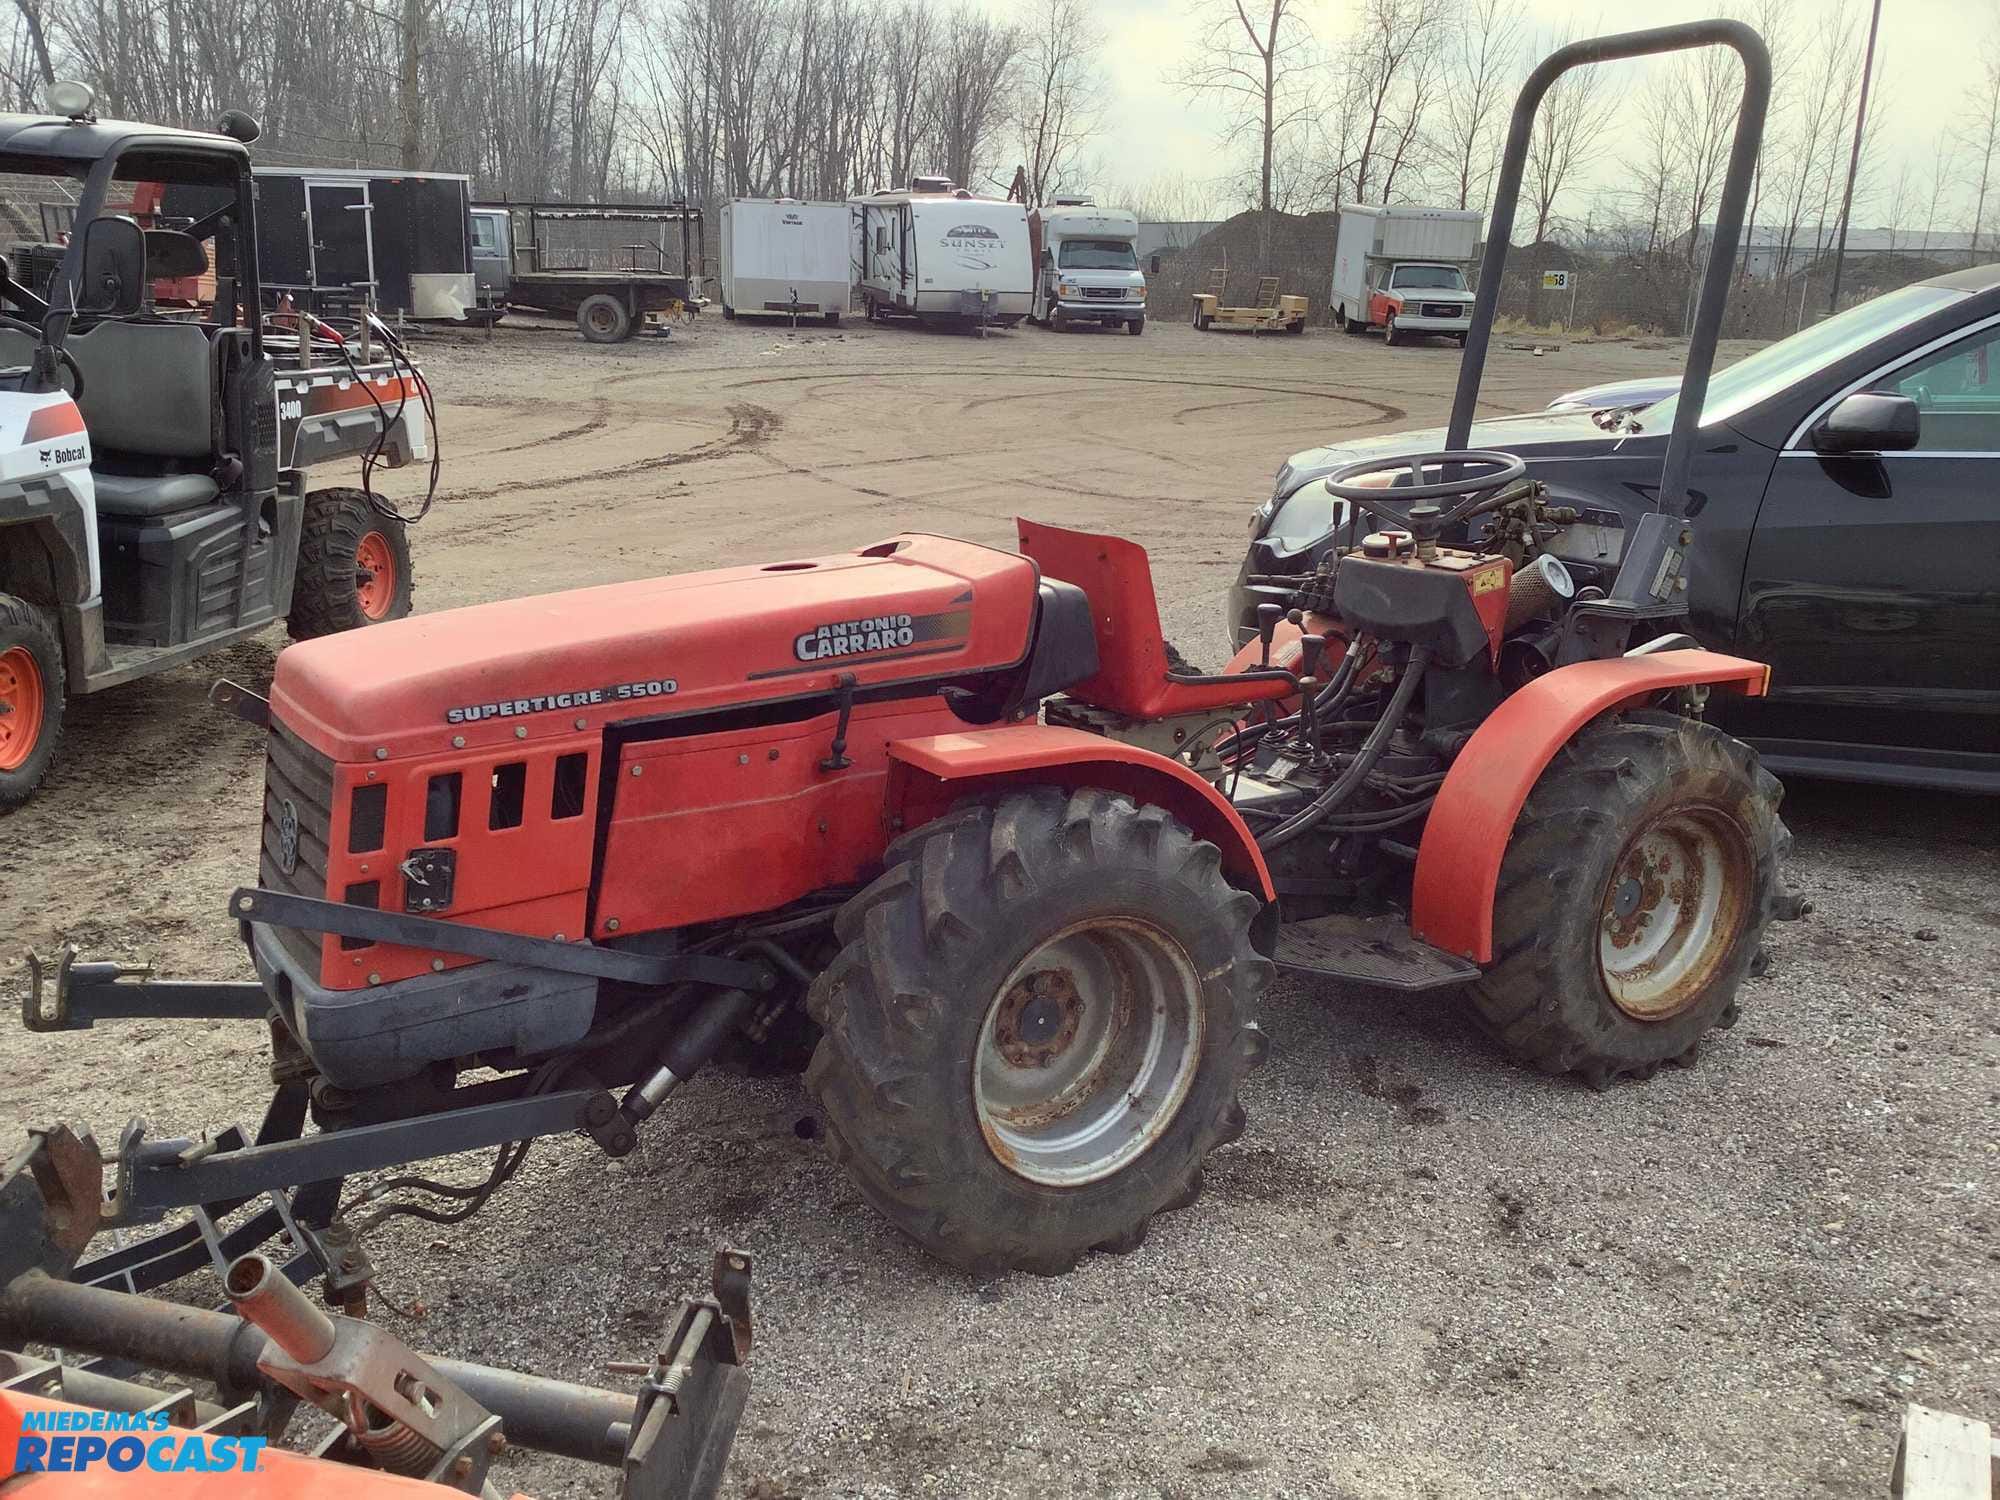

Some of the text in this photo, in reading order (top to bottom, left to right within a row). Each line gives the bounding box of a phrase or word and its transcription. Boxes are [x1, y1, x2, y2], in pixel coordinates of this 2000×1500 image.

[940, 239, 1005, 249] SUNSET
[280, 400, 302, 420] 3400
[55, 445, 86, 464] Bobcat
[817, 614, 912, 639] ANTONIO
[796, 627, 914, 660] CARRARO
[448, 679, 678, 723] SUPERTIGRE 5500
